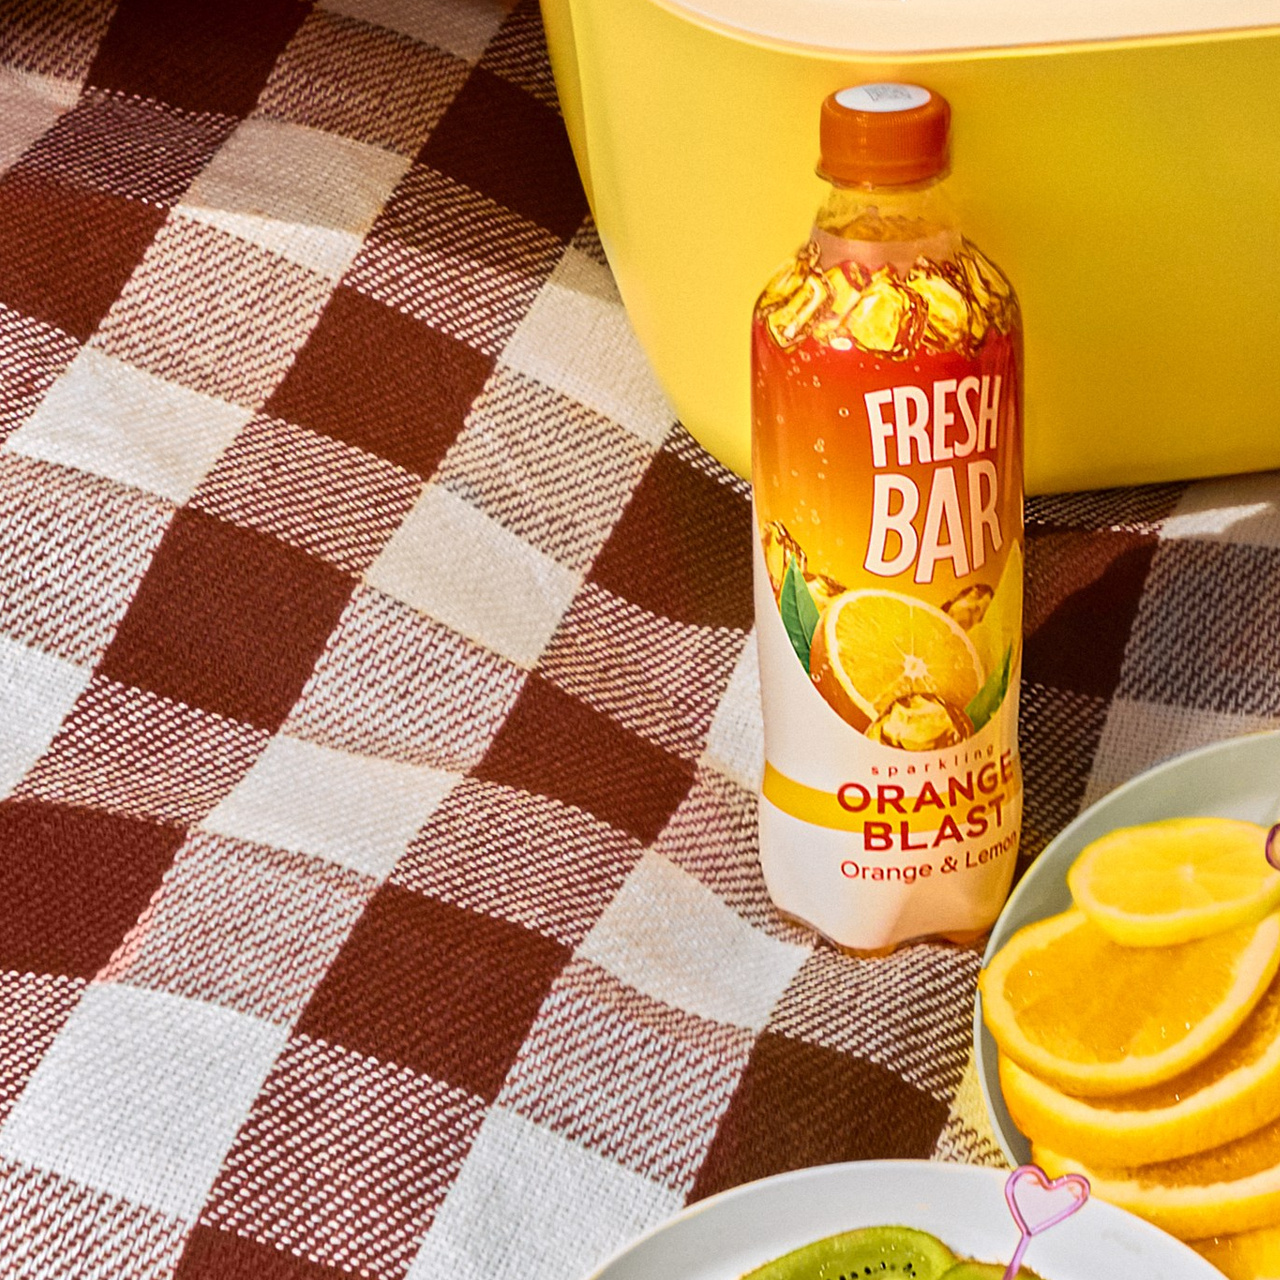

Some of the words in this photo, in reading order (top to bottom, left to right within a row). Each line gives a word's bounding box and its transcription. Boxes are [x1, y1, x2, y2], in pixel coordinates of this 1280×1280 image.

[864, 375, 1001, 468] FRESH
[864, 459, 1003, 584] BAR
[837, 748, 1013, 814] ORANGE
[871, 744, 994, 777] sparkling
[864, 793, 1005, 852] BLAST
[840, 860, 932, 884] Orange
[940, 856, 957, 873] &
[965, 830, 1017, 869] Lemon
